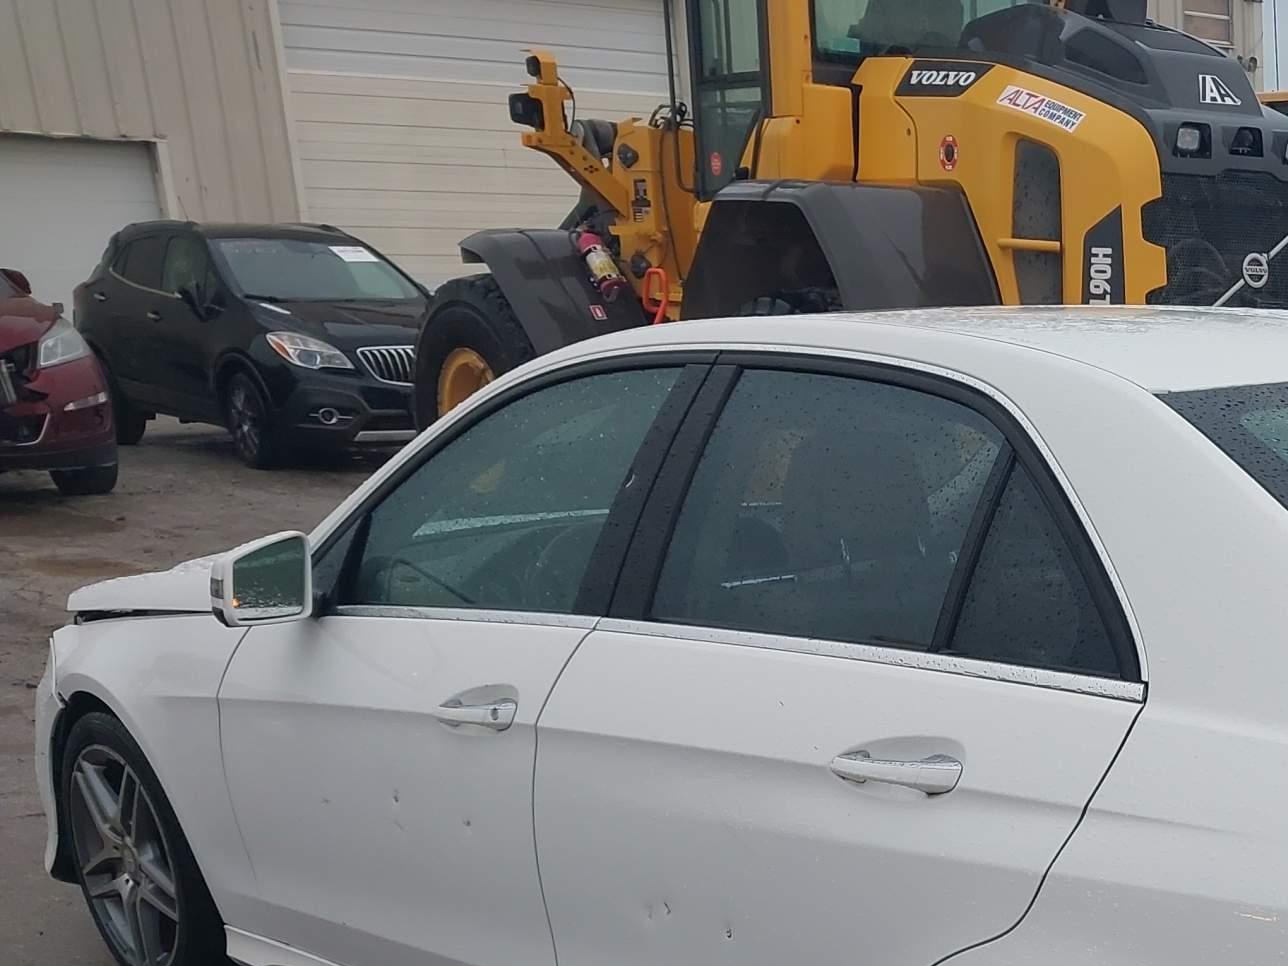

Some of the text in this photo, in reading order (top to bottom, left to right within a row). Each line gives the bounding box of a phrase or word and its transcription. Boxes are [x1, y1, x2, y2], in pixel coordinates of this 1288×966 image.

[909, 70, 977, 87] VOLVO
[999, 88, 1047, 114] ALTA
[1043, 99, 1083, 122] EQUIPMENT
[1038, 108, 1077, 130] COMPANY
[1089, 247, 1113, 305] L90H
